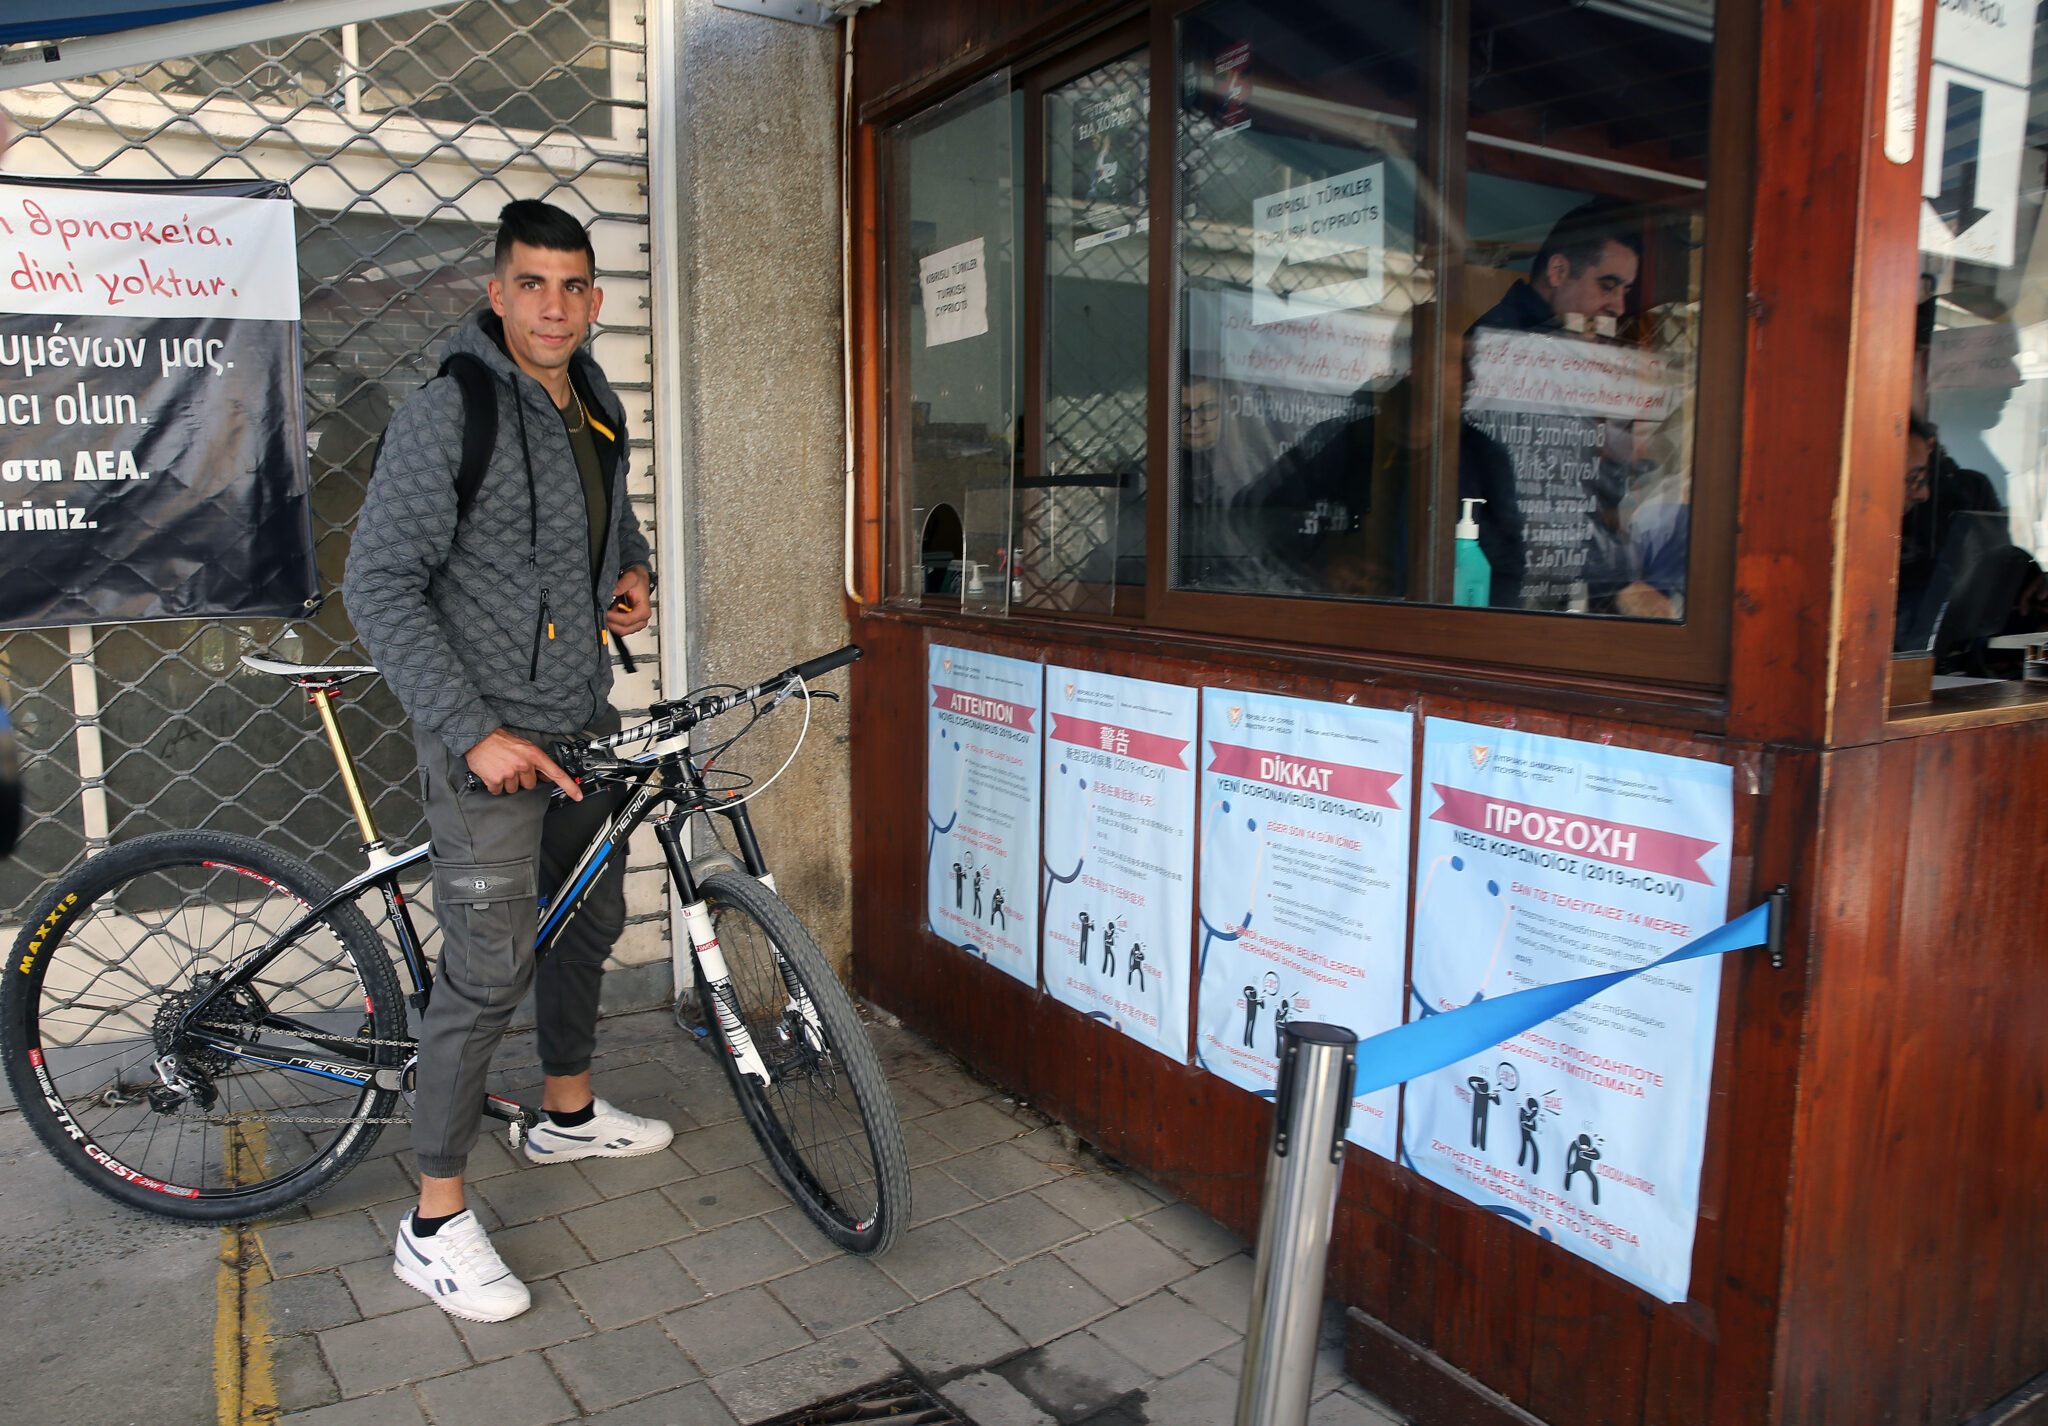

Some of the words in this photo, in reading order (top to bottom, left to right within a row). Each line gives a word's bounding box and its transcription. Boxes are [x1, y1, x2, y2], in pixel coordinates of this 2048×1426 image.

[1315, 177, 1373, 206] TÜRKLER
[1310, 204, 1380, 235] CYPRIOTS
[10, 251, 84, 294] dini
[95, 258, 239, 306] yoktur.
[159, 335, 235, 379] μας.
[55, 382, 149, 426] olun.
[2, 458, 62, 483] στη
[74, 450, 151, 482] ΔΕΑ.
[951, 692, 1014, 724] ATTENTION
[1099, 725, 1131, 756] 警告
[1260, 754, 1334, 793] DİKKAT
[609, 780, 656, 846] MERIDA
[1217, 778, 1241, 795] YENİ
[1317, 799, 1384, 829] (2019-nCoV)
[1485, 803, 1638, 861] ΠΡΟΣΟΧΗ
[1453, 830, 1487, 852] ΝΕΟΣ
[1581, 862, 1685, 903] (2019-nCoV)
[19, 892, 79, 975] MAXXIS
[1626, 911, 1641, 924] 14
[288, 1057, 372, 1082] MERIDA
[45, 1095, 85, 1141] ZTR
[83, 1143, 144, 1182] CREST
